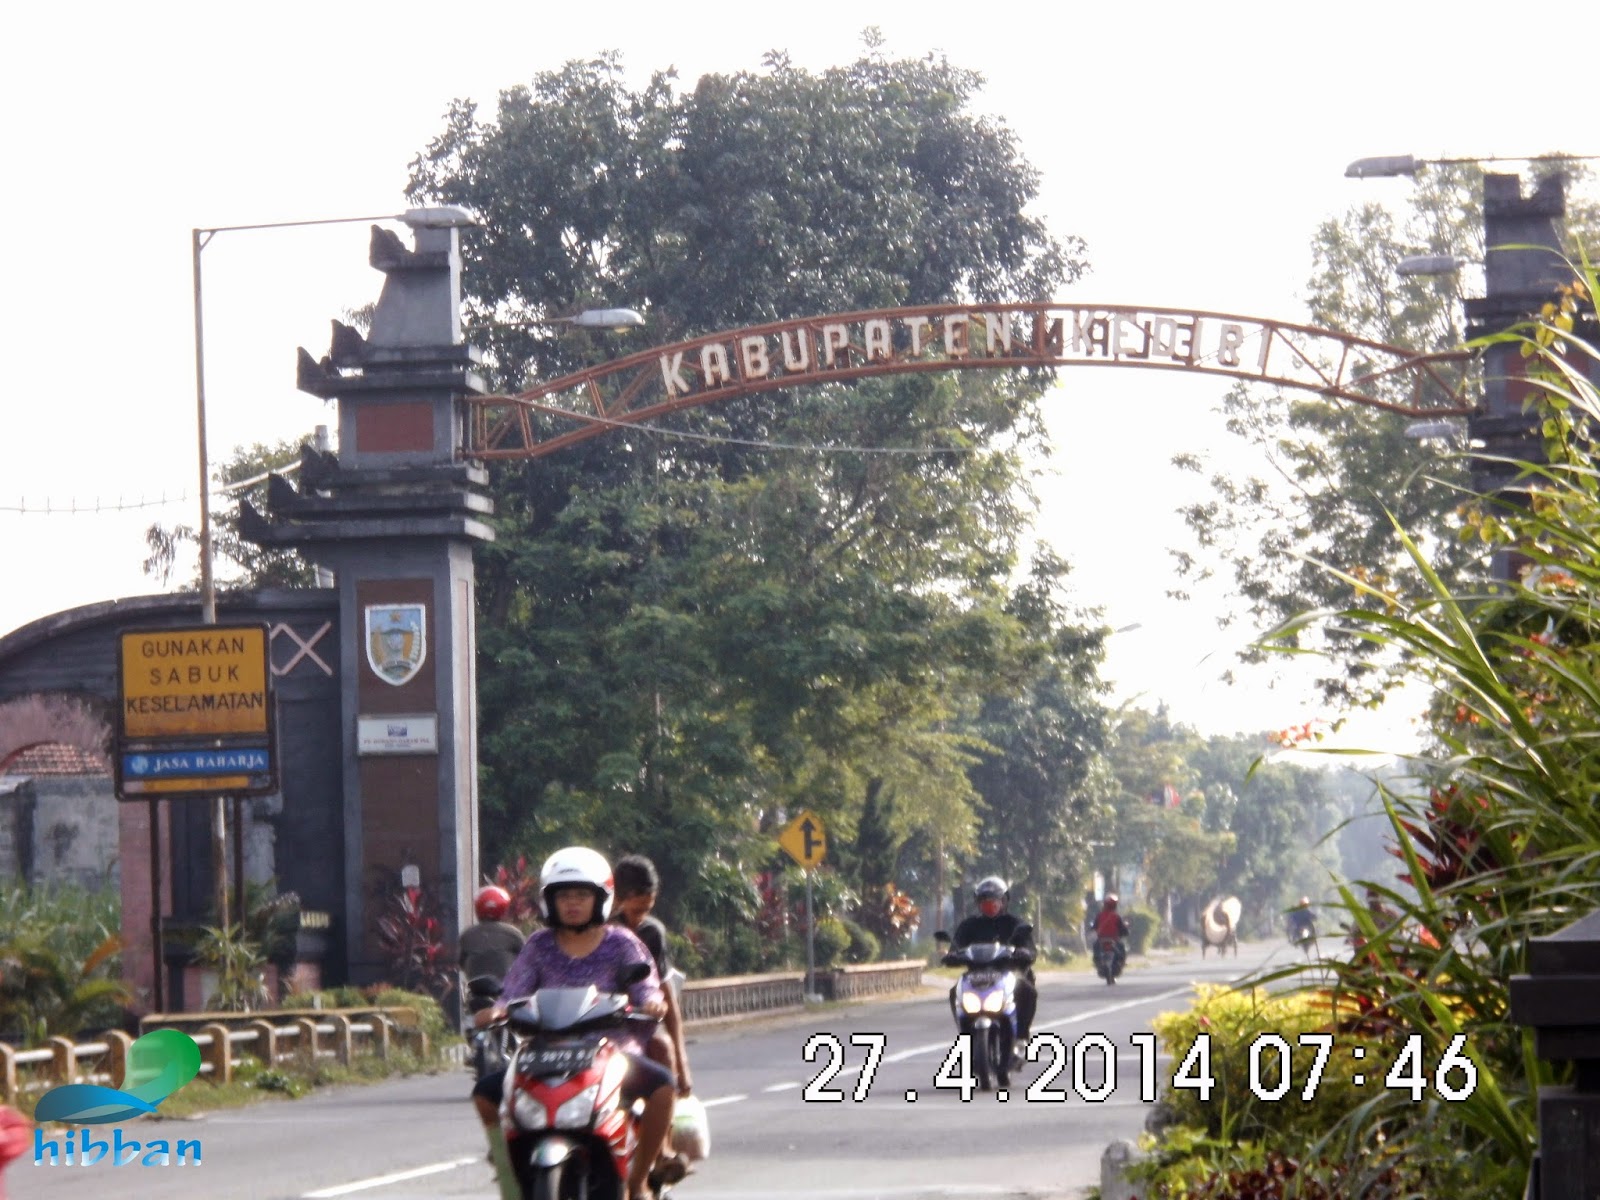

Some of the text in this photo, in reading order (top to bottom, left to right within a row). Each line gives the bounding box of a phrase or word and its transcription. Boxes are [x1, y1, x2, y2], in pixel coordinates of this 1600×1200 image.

[659, 309, 1271, 398] KABUPATEN KEDIRI
[142, 637, 244, 658] GUNAKAN
[150, 664, 239, 686] SABUK
[126, 692, 263, 713] KESELAMATAN
[153, 753, 264, 773] JASA RAHARJA
